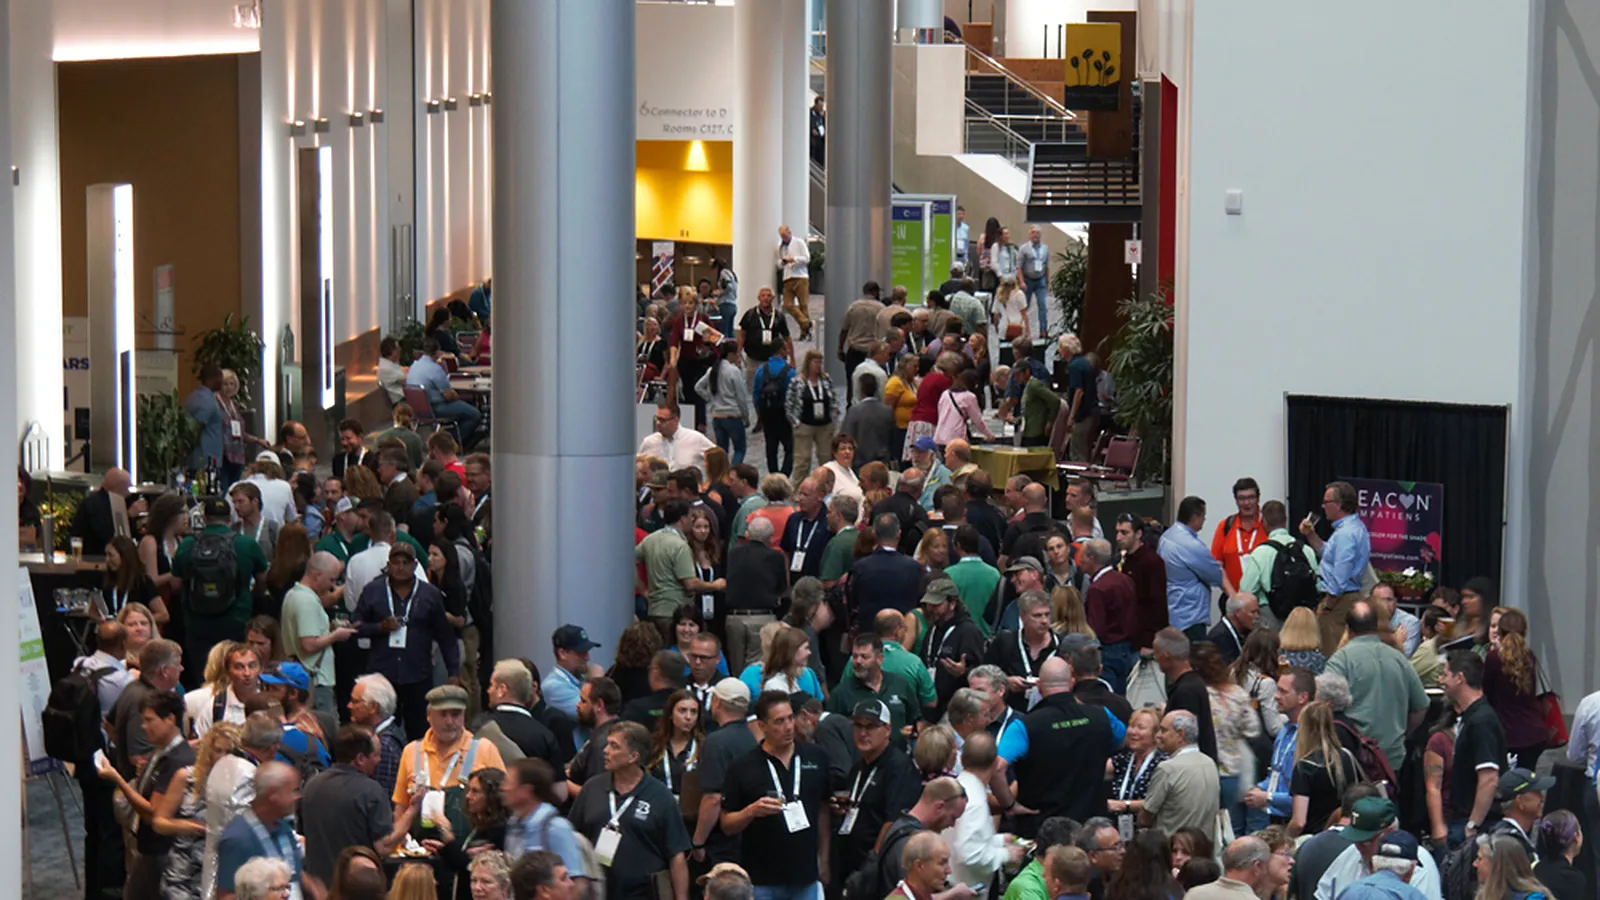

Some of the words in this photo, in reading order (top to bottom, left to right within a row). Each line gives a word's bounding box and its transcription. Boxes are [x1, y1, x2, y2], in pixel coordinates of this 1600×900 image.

[650, 107, 703, 117] Connector
[706, 108, 717, 118] to
[663, 123, 697, 134] Rooms
